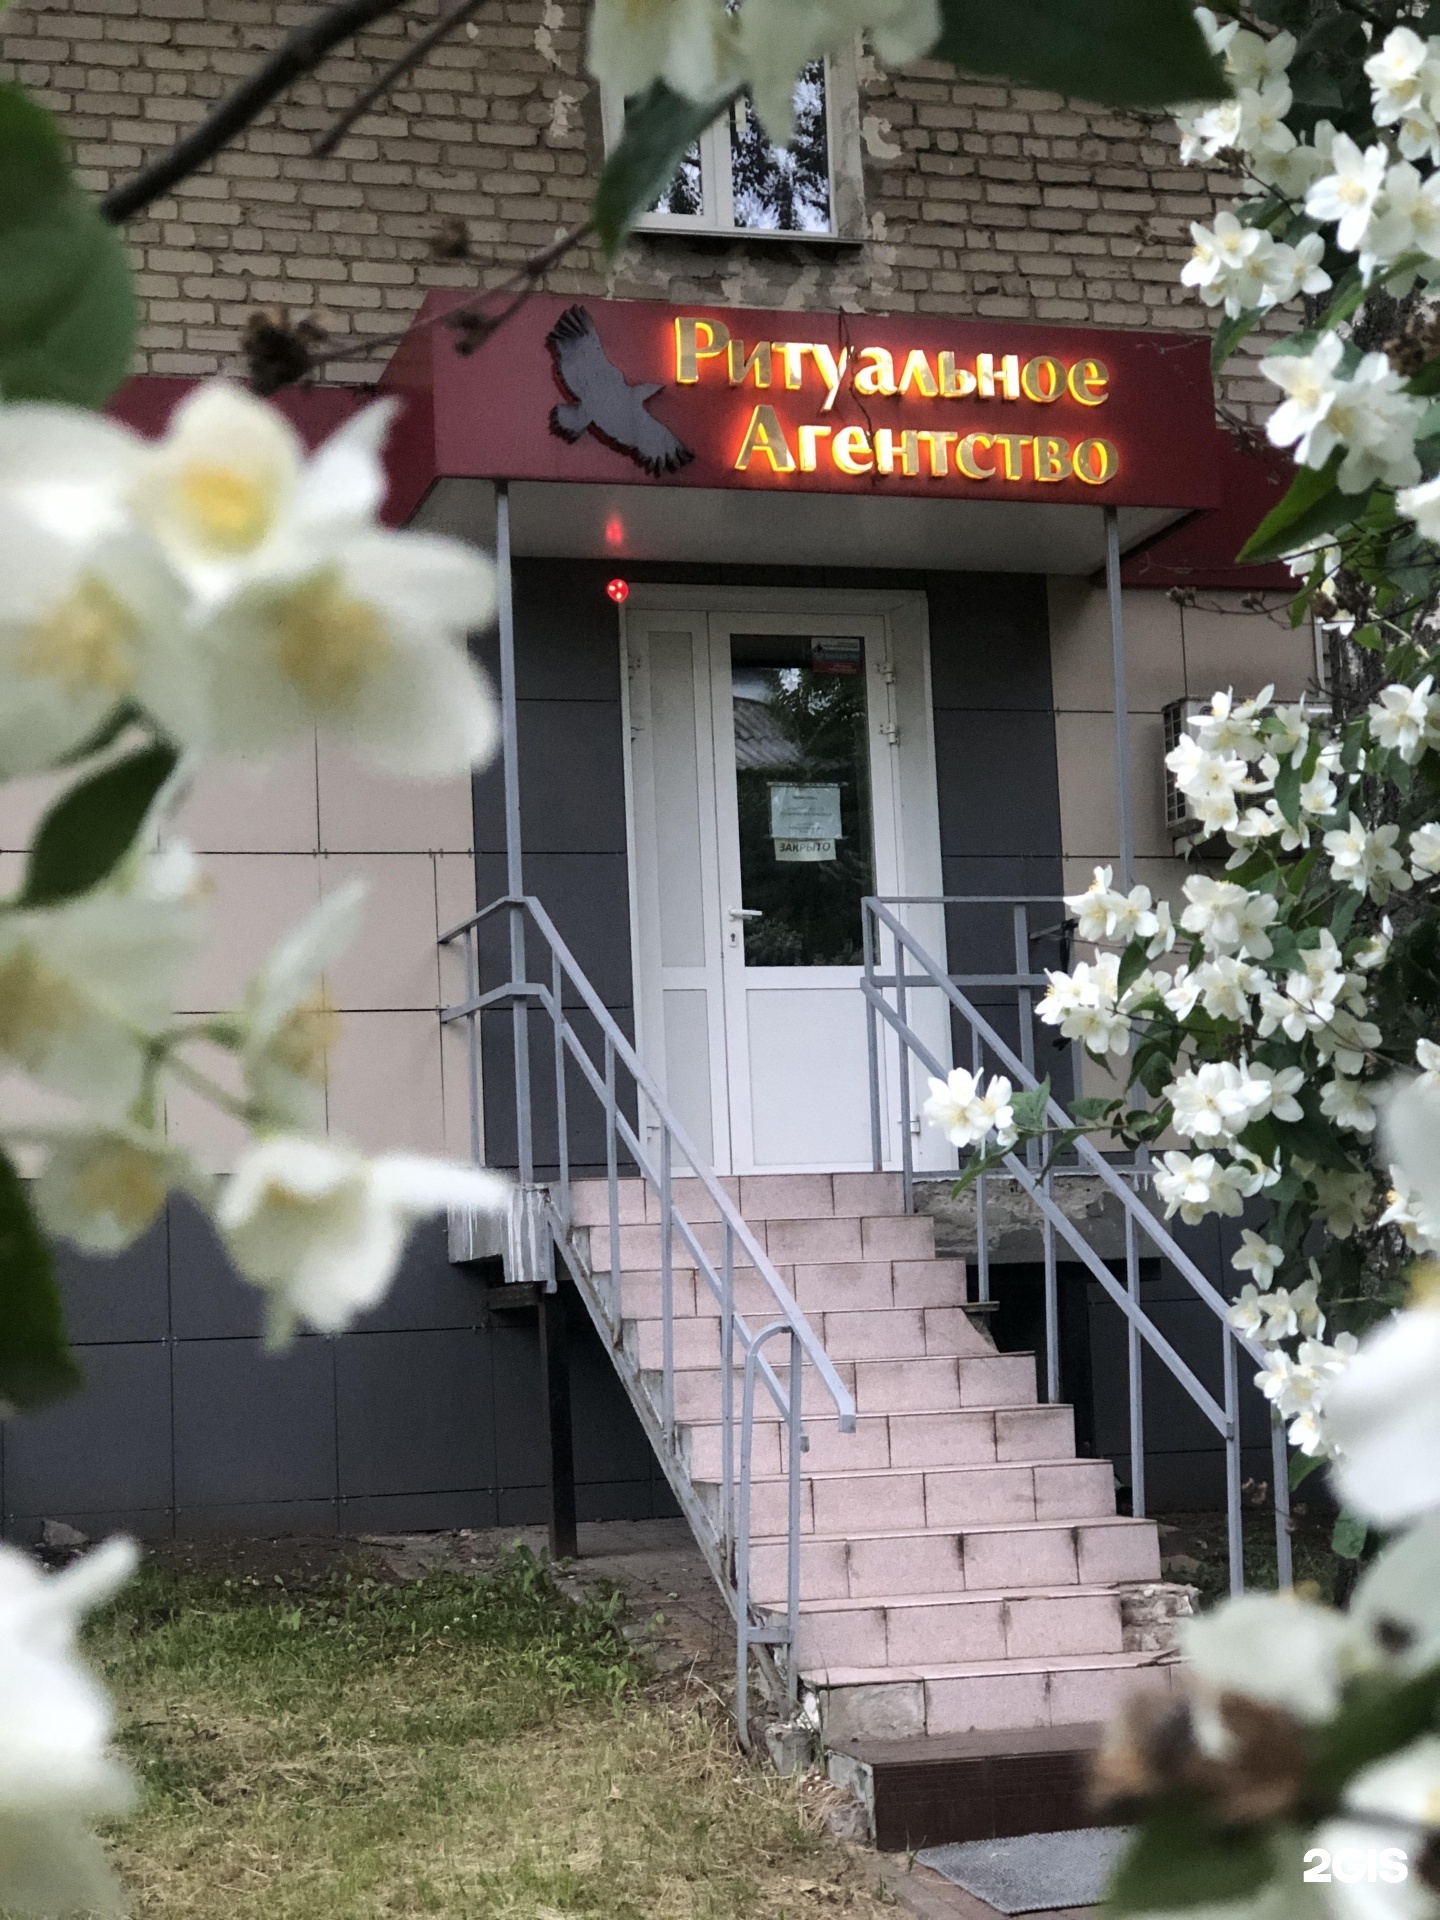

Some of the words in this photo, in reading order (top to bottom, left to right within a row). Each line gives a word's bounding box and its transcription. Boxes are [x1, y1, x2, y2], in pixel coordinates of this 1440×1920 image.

[675, 316, 1110, 412] Ритуальное
[734, 404, 1119, 485] Агентство
[779, 842, 831, 853] ЗАКРЫТО
